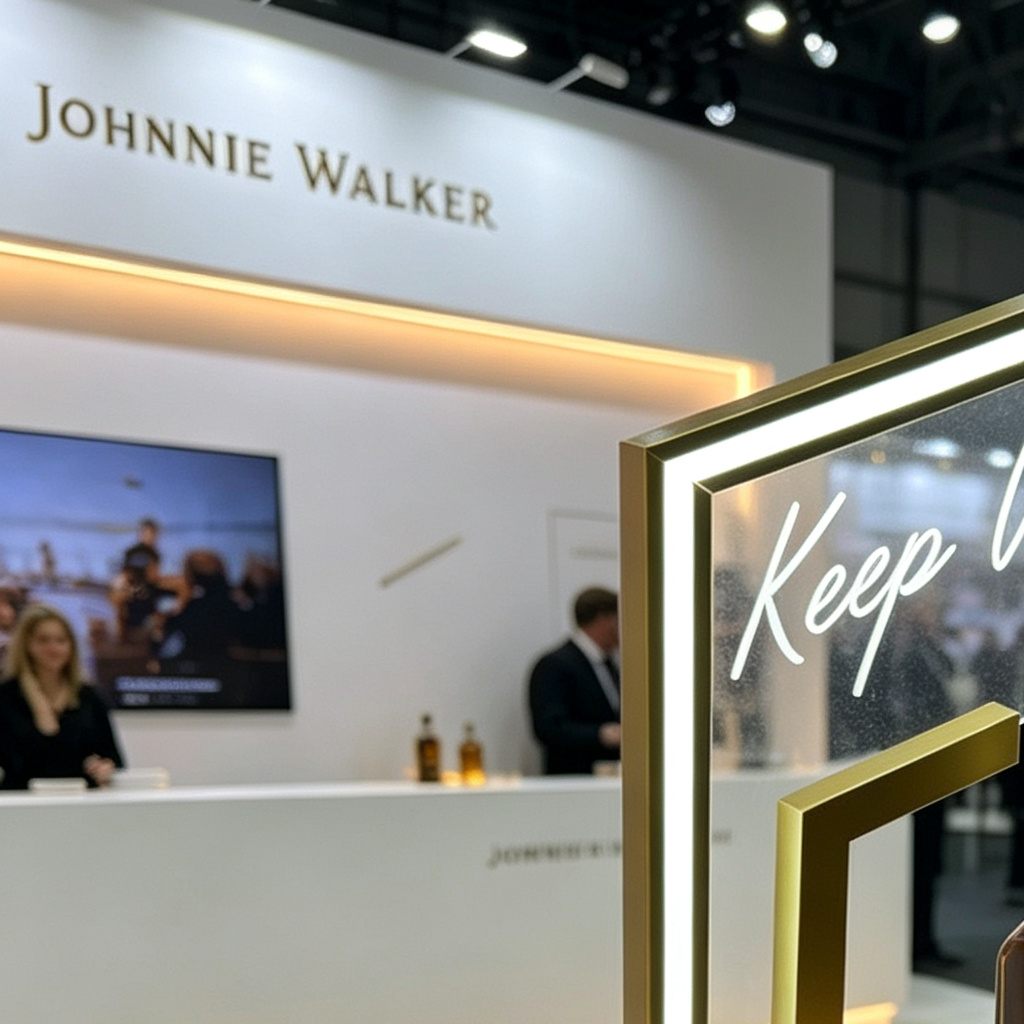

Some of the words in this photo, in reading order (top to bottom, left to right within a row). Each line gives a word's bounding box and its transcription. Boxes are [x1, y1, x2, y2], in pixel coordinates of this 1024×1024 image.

[26, 82, 274, 182] JOHNNIE
[294, 142, 498, 230] WALKER
[730, 491, 957, 697] Keep
